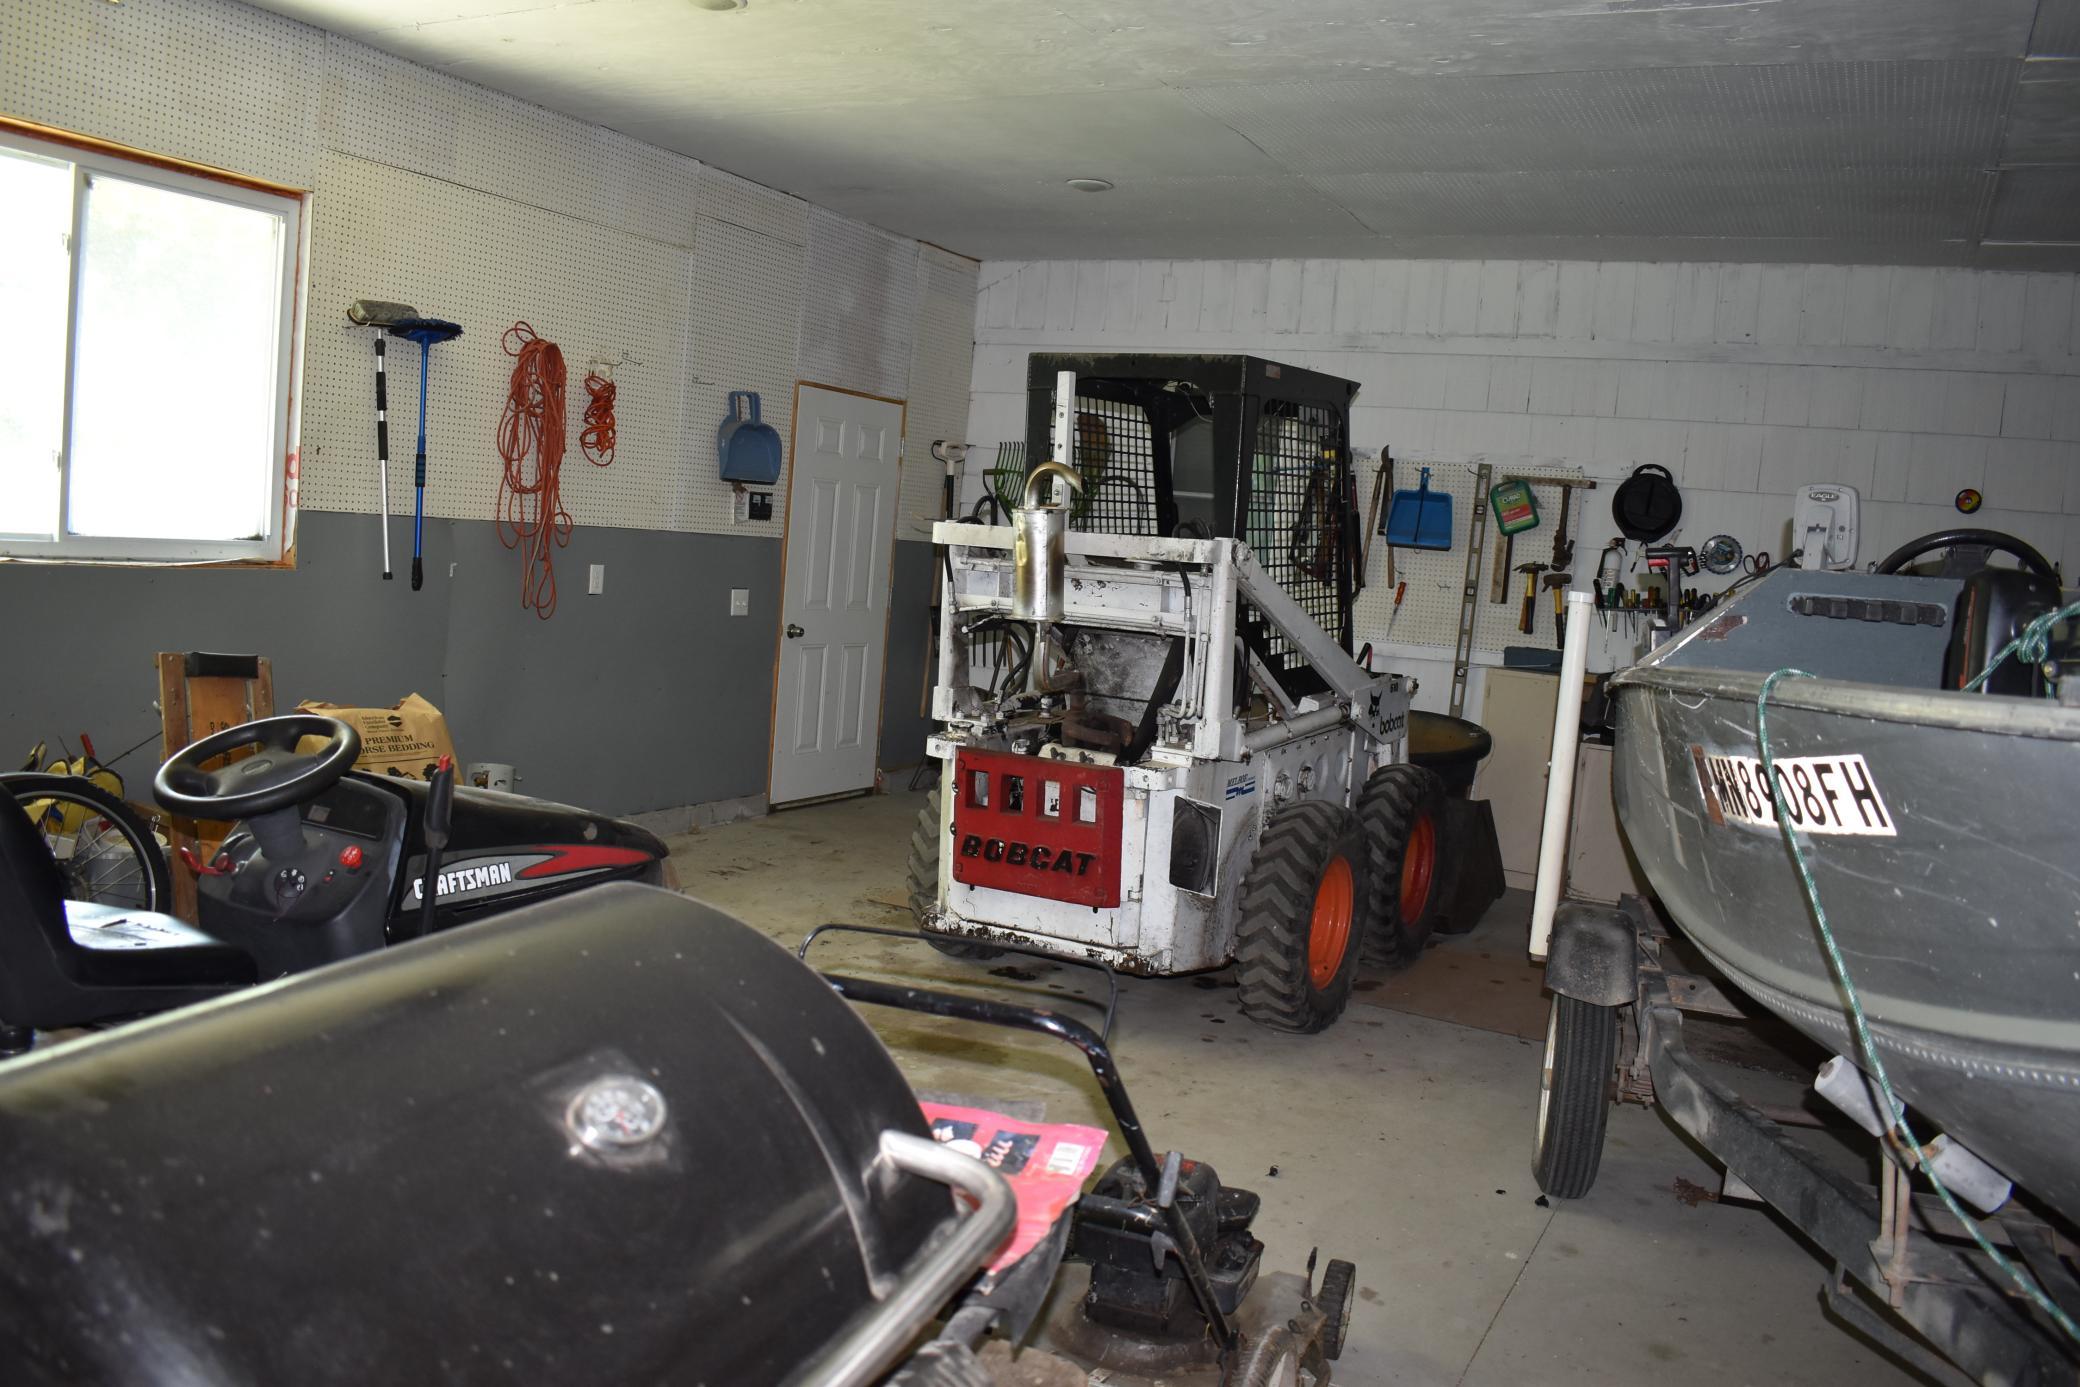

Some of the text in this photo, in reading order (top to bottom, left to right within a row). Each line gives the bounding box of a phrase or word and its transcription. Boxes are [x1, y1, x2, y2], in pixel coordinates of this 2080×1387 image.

[1380, 712, 1405, 735] bobcat
[360, 745, 387, 754] ORSE
[388, 742, 435, 752] BEDDING
[365, 734, 414, 745] PREMIUM
[961, 834, 1097, 876] BOBCAT
[413, 862, 512, 900] CAFTSMAN
